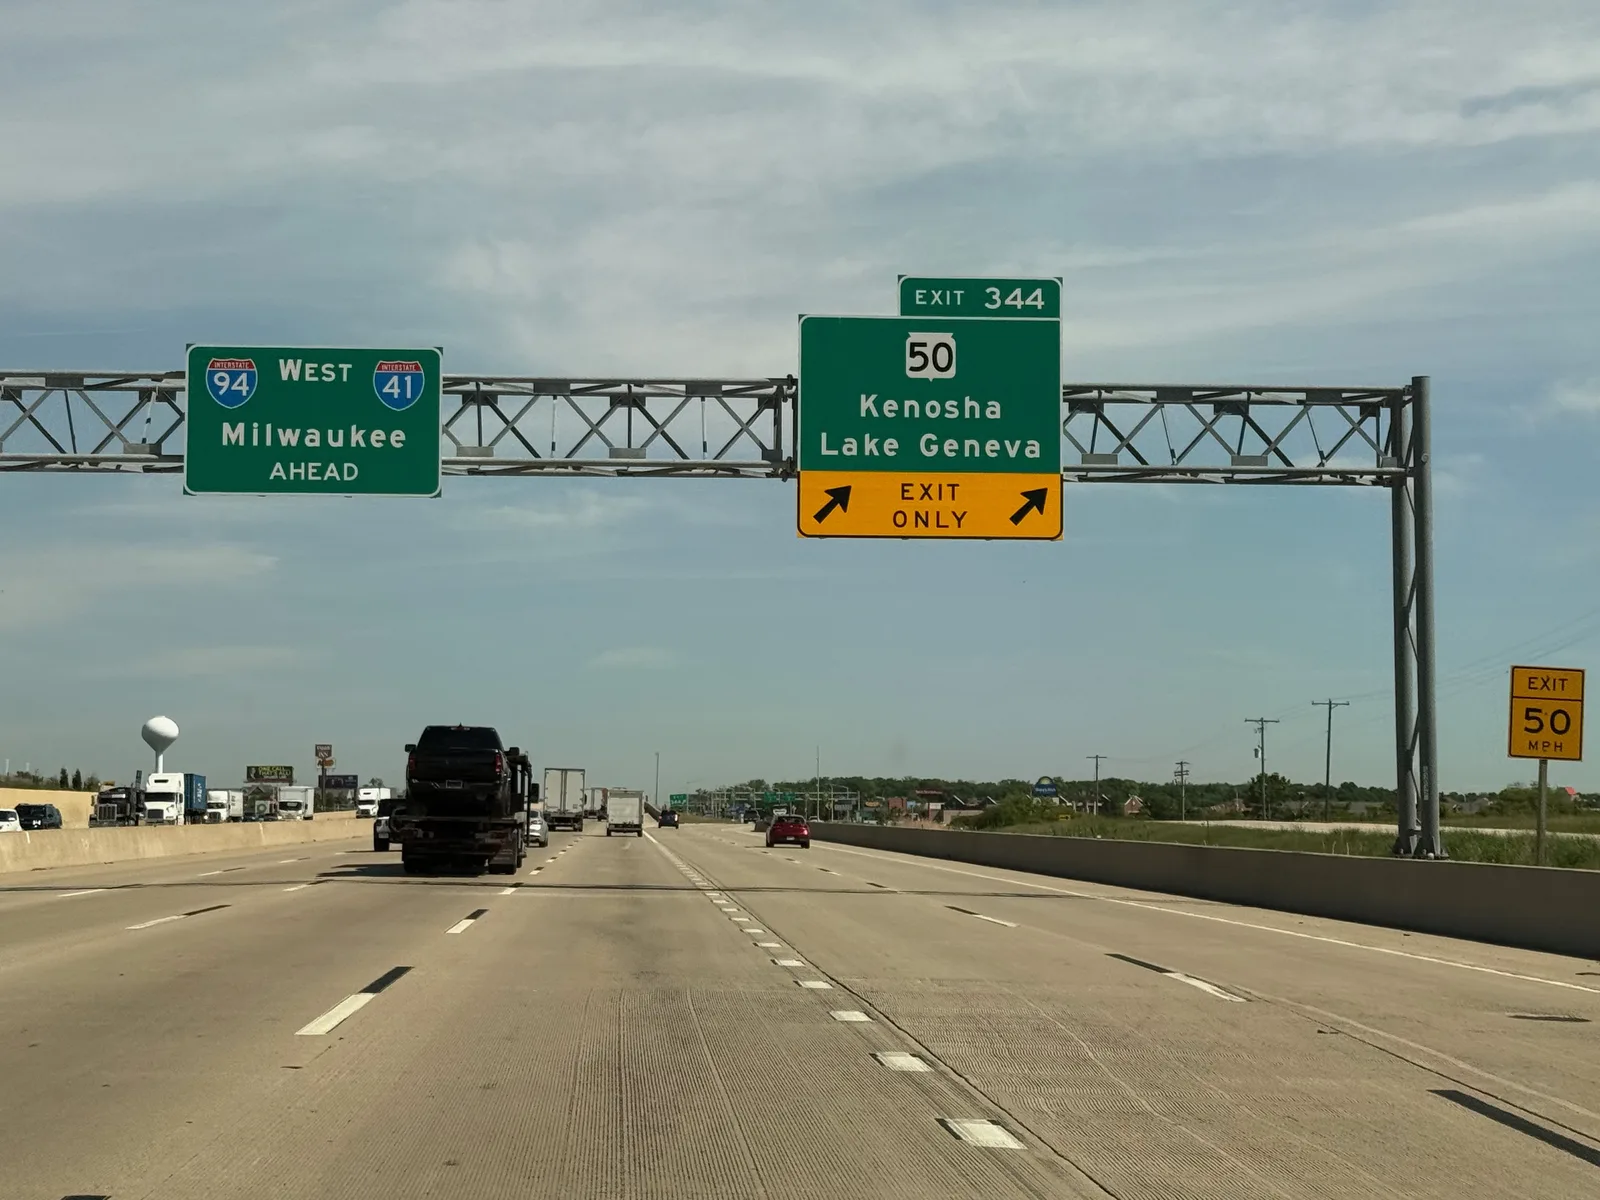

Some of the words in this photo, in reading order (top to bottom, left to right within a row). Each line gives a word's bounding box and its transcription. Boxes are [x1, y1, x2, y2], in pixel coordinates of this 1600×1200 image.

[916, 290, 965, 305] EXIT
[984, 287, 1045, 309] 344
[214, 361, 250, 369] INTERSTATE
[908, 341, 953, 373] 50
[213, 371, 249, 397] 94
[382, 375, 412, 399] 41
[860, 394, 1001, 419] Kenosha
[222, 422, 406, 449] Milwaukee
[821, 432, 899, 457] Lake
[919, 433, 1041, 459] Geneva
[269, 462, 359, 481] AHEAD
[901, 483, 960, 501] EXIT
[892, 510, 968, 528] ONLY
[1527, 676, 1568, 691] EXIT
[1524, 707, 1571, 735] 50
[1528, 740, 1563, 753] MPH
